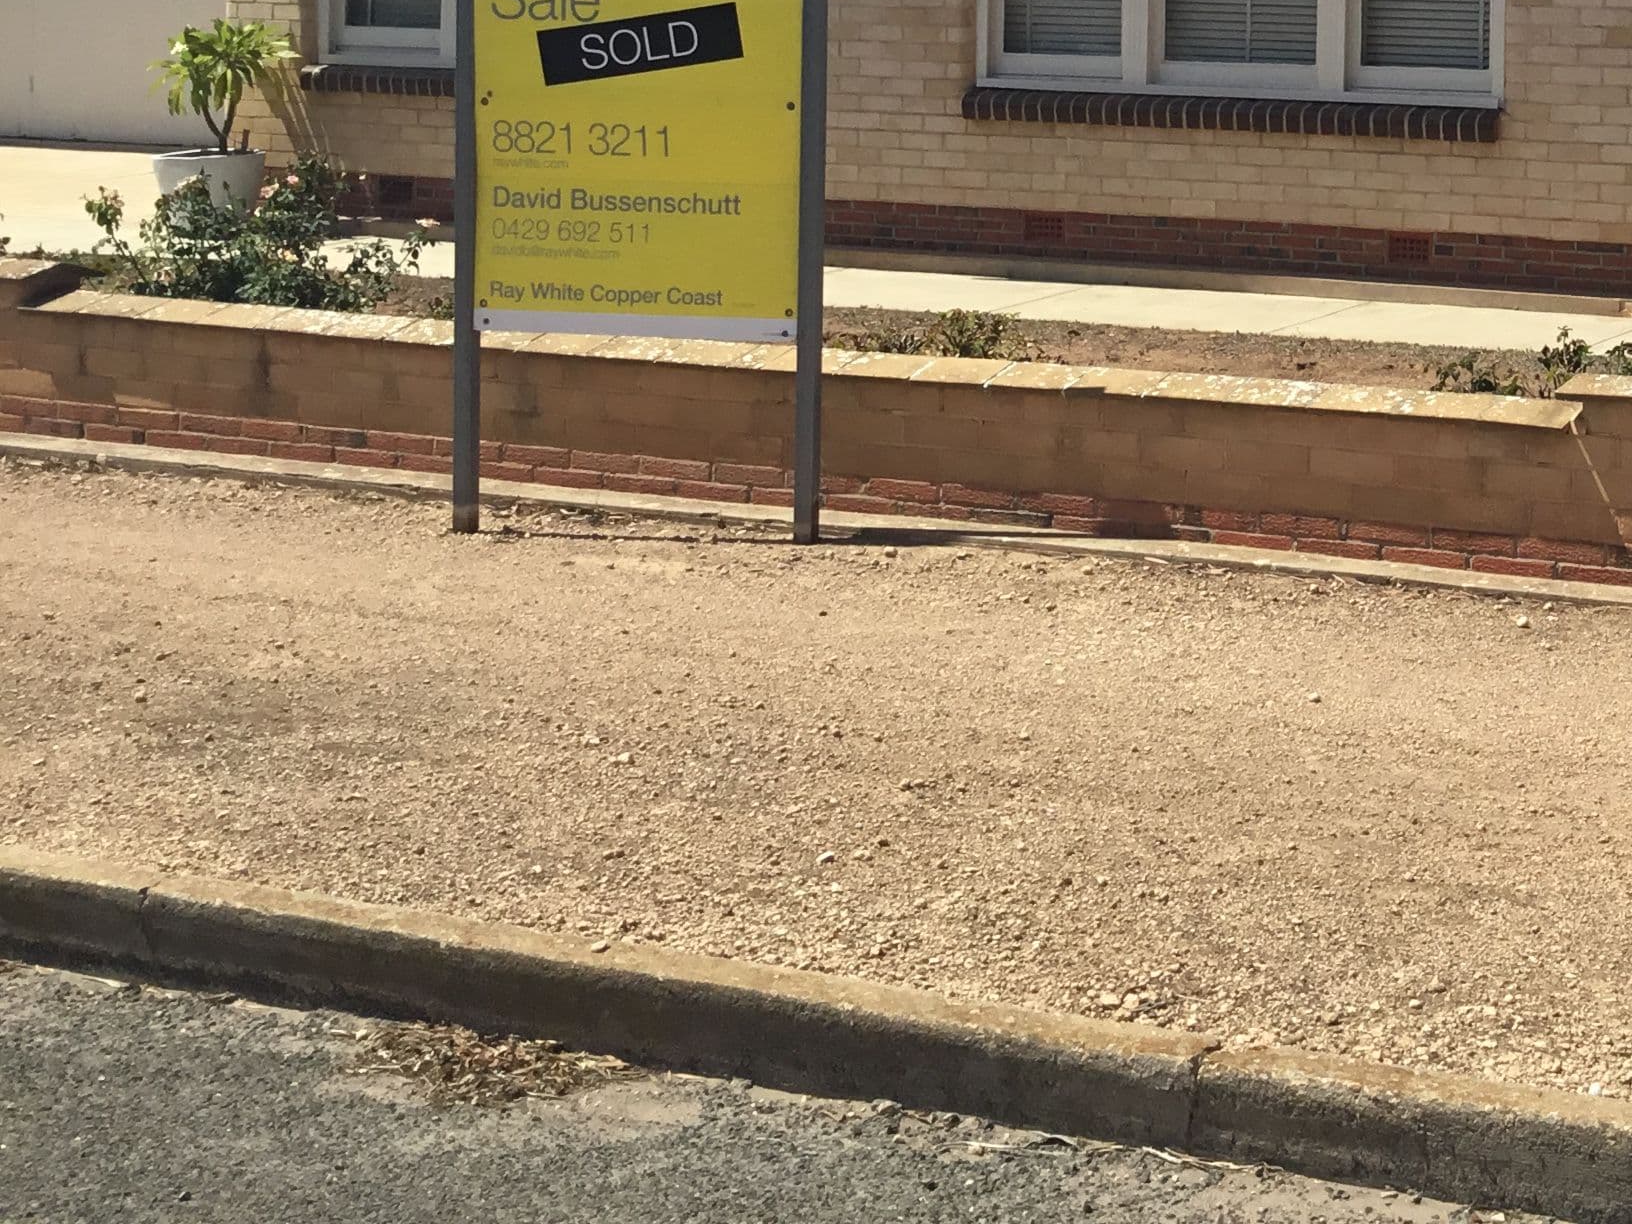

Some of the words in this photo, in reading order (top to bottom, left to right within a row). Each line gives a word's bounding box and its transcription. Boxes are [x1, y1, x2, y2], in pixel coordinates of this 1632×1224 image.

[579, 21, 699, 70] SOLD
[492, 119, 572, 155] 8821
[588, 122, 671, 158] 3211
[492, 186, 561, 210] David
[570, 188, 741, 216] Bussenschutt
[491, 218, 550, 241] 0429
[558, 219, 601, 243] 692
[608, 223, 650, 244] 511
[489, 280, 525, 302] Ray
[530, 282, 584, 302] White
[590, 285, 660, 307] Copper
[666, 287, 723, 306] Coast
